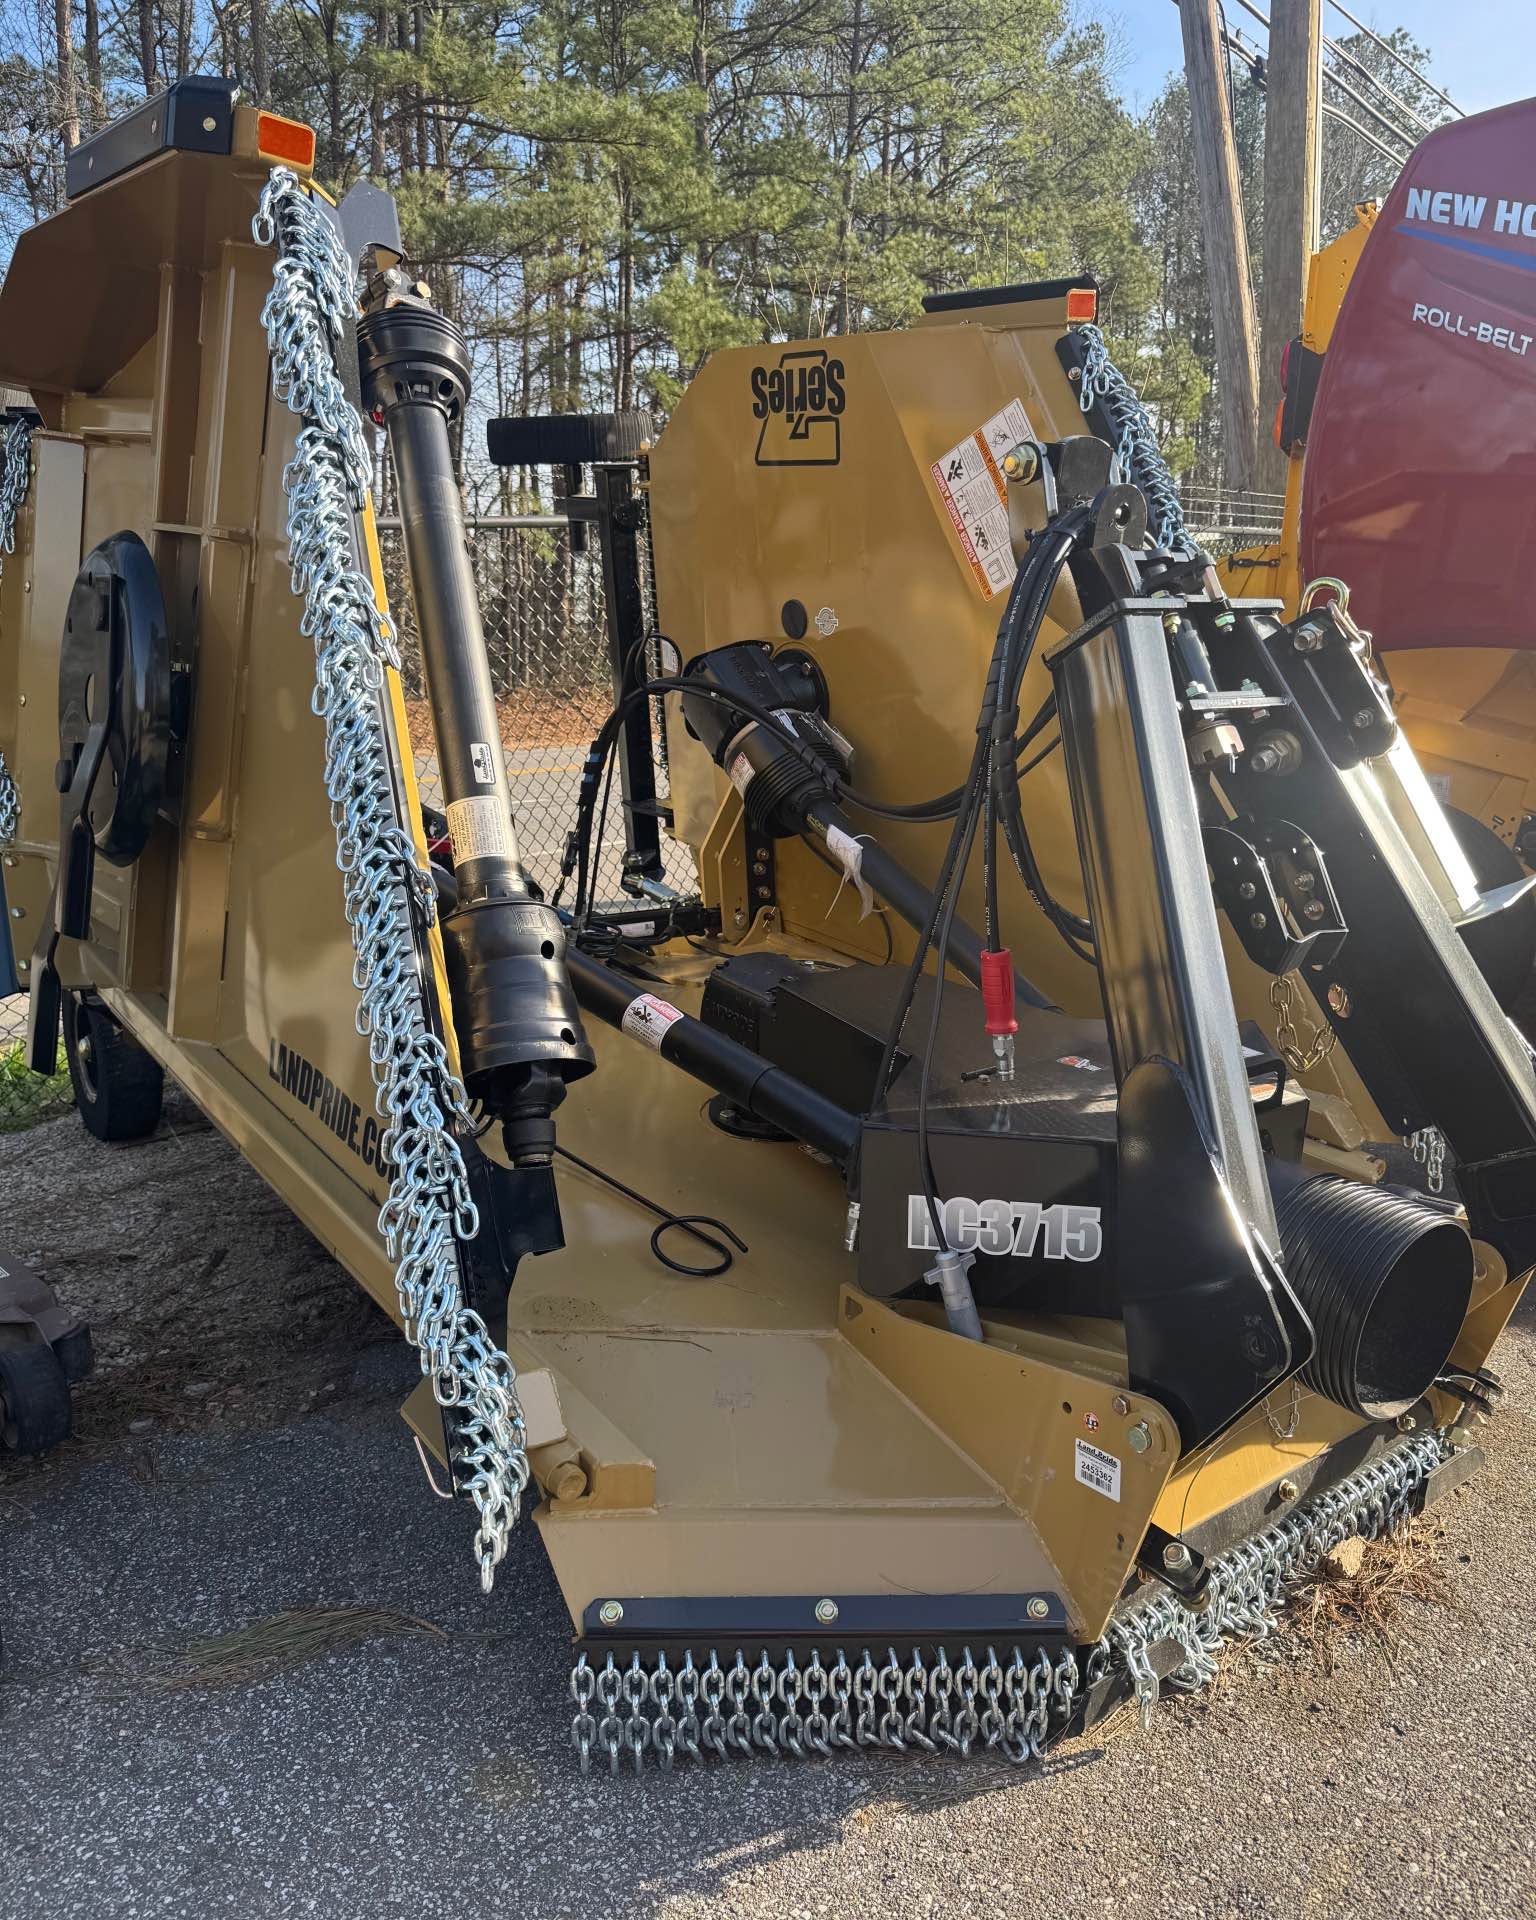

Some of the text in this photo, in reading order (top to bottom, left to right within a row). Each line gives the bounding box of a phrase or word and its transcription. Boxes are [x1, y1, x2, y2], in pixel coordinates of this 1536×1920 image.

[1405, 187, 1488, 230] NEW
[1412, 302, 1534, 357] ROLL-BELT
[751, 359, 845, 424] Series
[907, 1194, 1103, 1263] RC3715
[1081, 1462, 1113, 1484] 2453362
